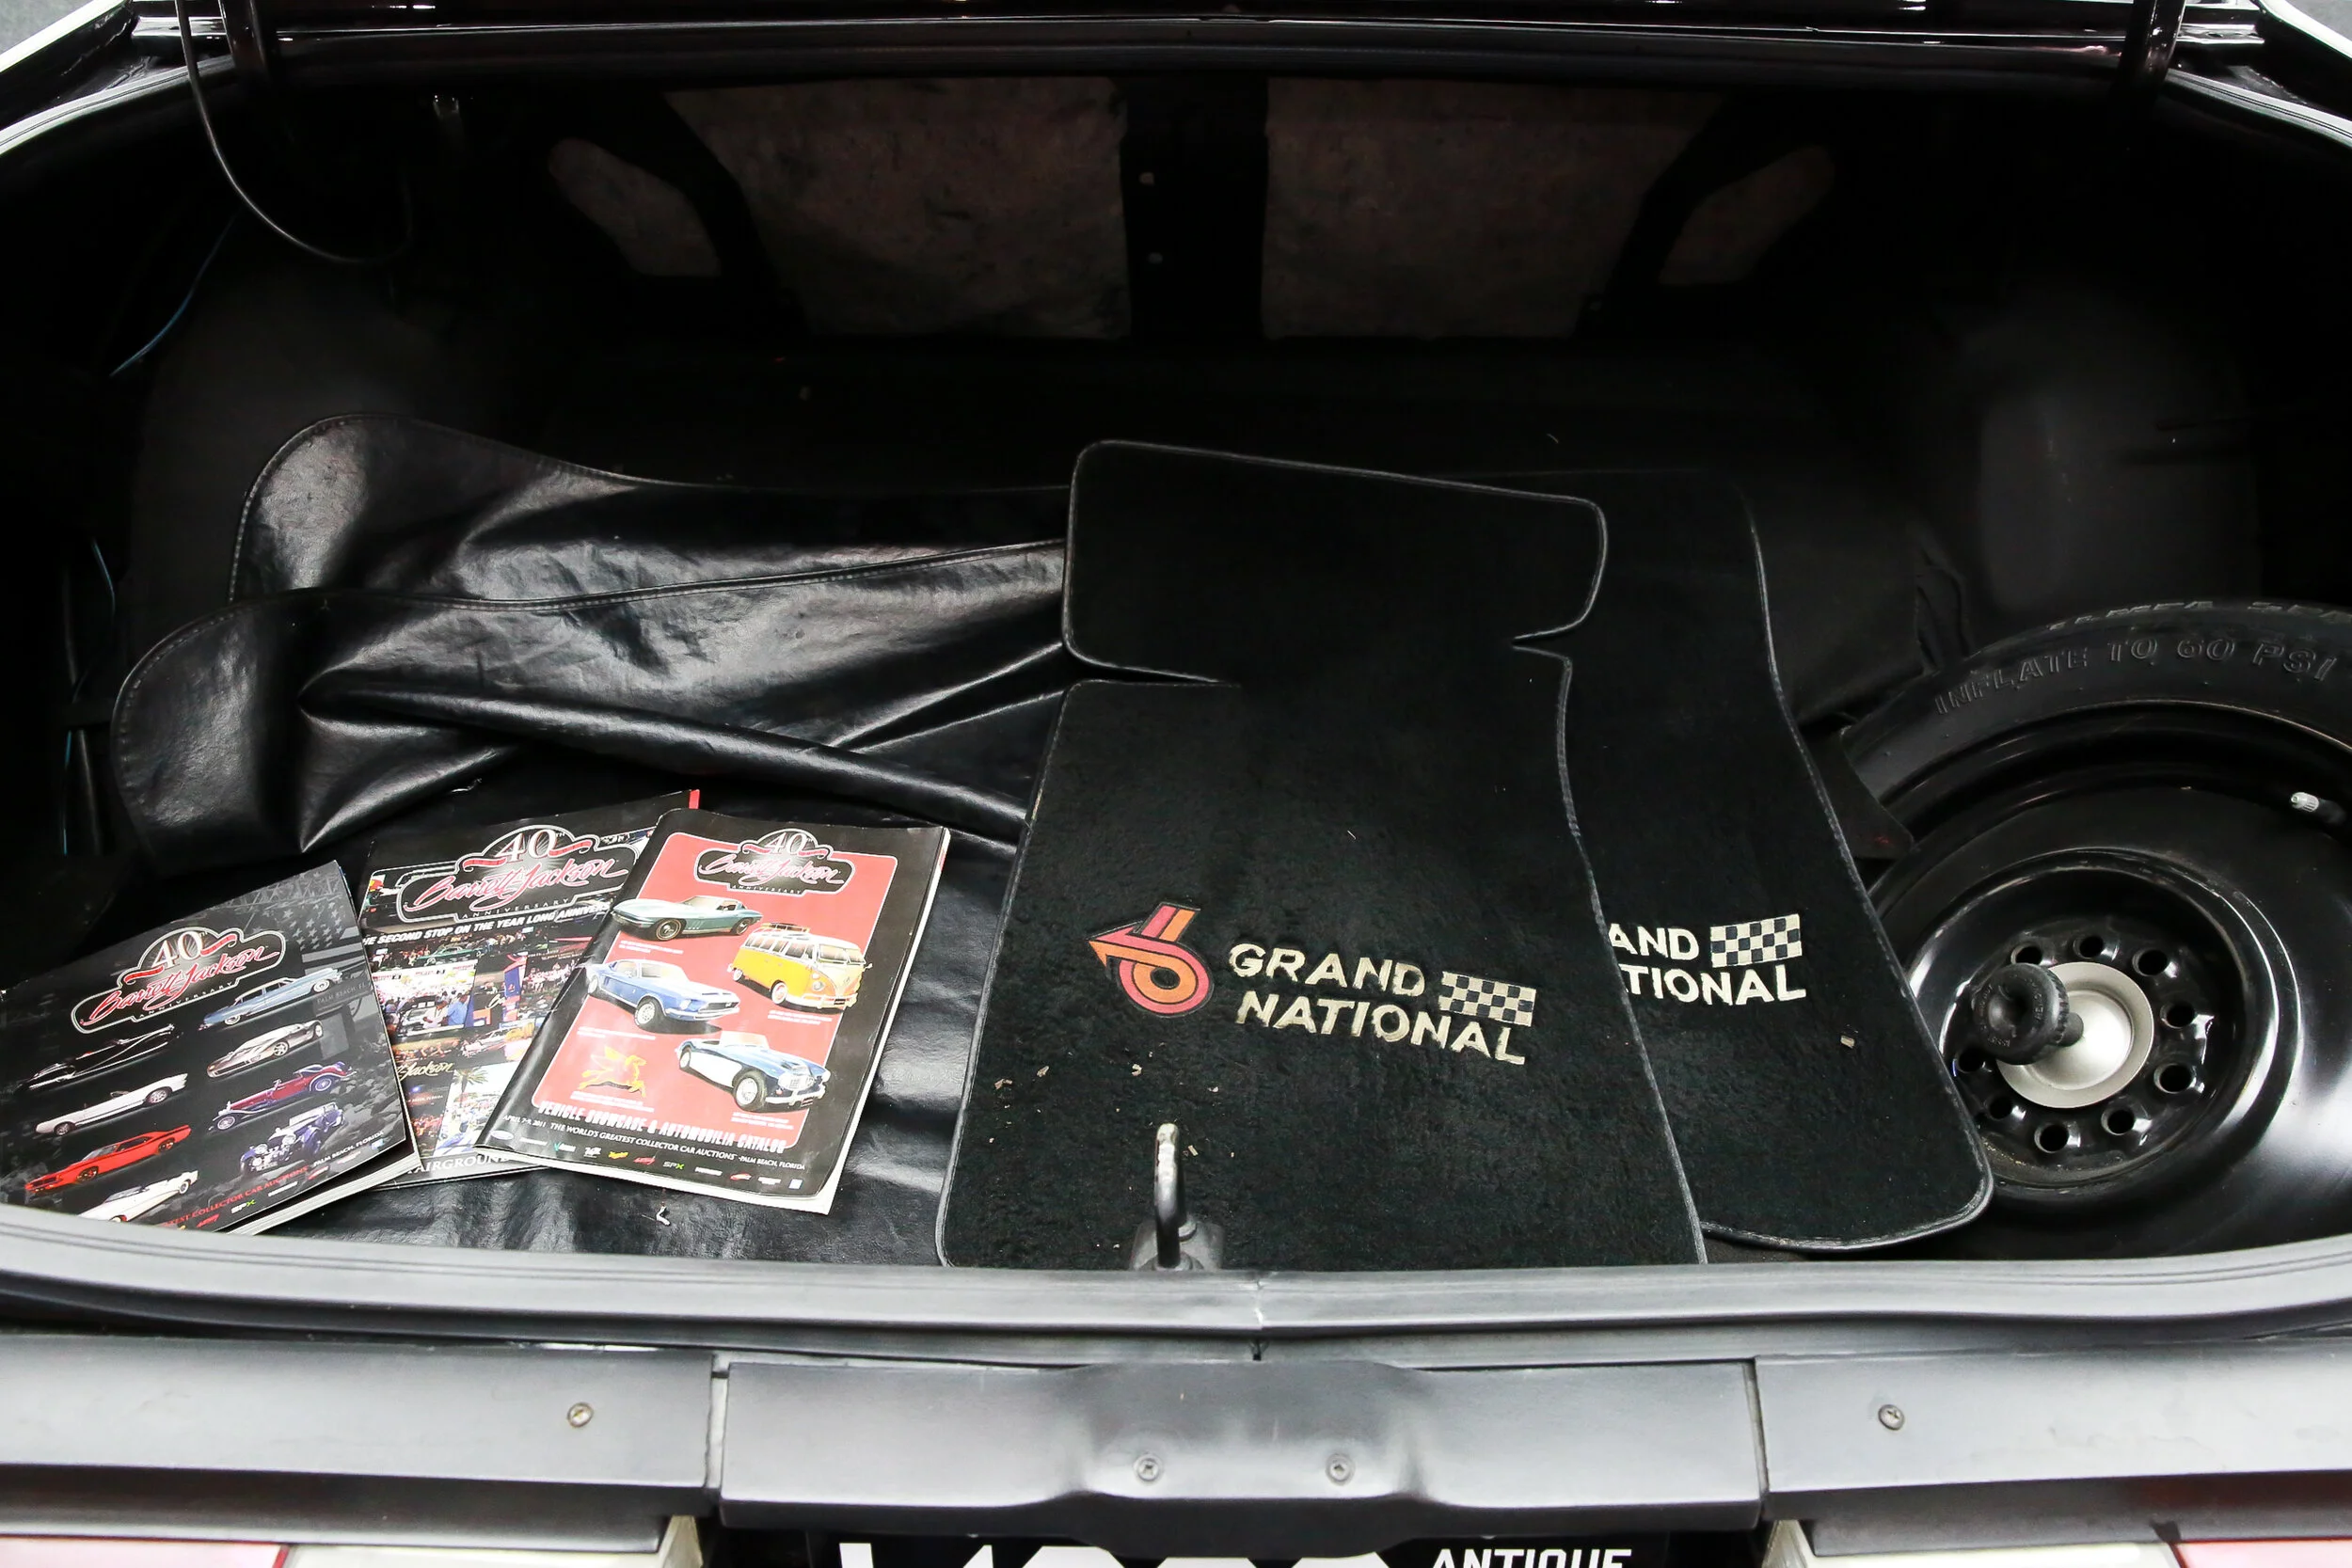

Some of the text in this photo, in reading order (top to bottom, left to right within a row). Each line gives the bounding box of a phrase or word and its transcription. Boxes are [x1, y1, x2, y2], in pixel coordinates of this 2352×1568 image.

[1934, 638, 2338, 715] INFLATE TO 60 PSI
[362, 936, 377, 945] HE
[377, 930, 422, 944] SECOND
[423, 927, 452, 939] STOP
[454, 925, 471, 935] ON
[473, 921, 495, 932] THE
[497, 917, 525, 928] YEAR
[527, 911, 556, 924] LONG
[461, 898, 569, 919] ANNIVERSARY
[1608, 923, 1700, 960] AND
[1229, 942, 1425, 997] GRAND
[1618, 963, 1806, 1006] TIONAL
[1235, 990, 1526, 1065] NATIONAL
[538, 1101, 585, 1121] VEHICLE
[585, 1108, 647, 1132] SHOWCASE
[659, 1121, 737, 1146] AUTOMOBILIA
[738, 1133, 787, 1154] CATALOG
[550, 1122, 565, 1132] THE
[599, 1132, 636, 1145] GREATEST
[636, 1138, 679, 1152] COLLECTOR
[679, 1144, 696, 1154] CAR
[778, 1162, 806, 1171] FLORIDA
[192, 1194, 244, 1218] COLLECTOR
[245, 1185, 263, 1196] CAR
